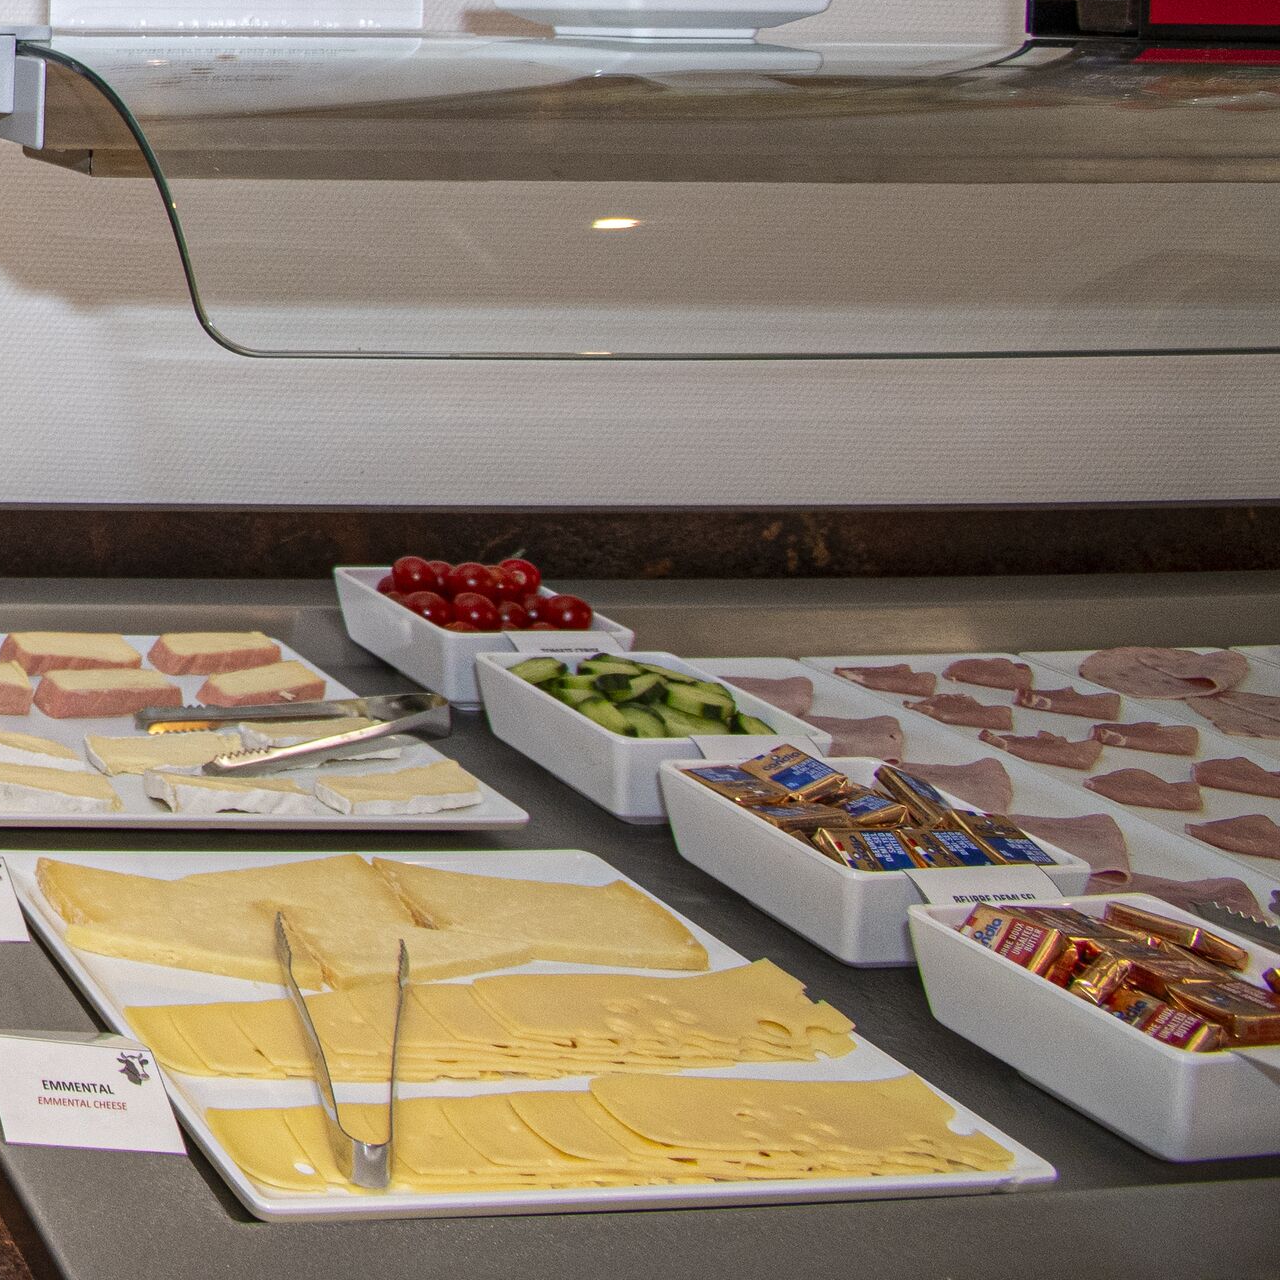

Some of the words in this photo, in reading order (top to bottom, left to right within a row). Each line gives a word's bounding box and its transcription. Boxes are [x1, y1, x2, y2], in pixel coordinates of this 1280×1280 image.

[1011, 925, 1035, 955] UNSALTED
[1024, 928, 1044, 952] BUTTER
[41, 1079, 116, 1096] EMMENTAL
[37, 1096, 92, 1109] EMMENTAL
[93, 1099, 128, 1111] CHEESE
